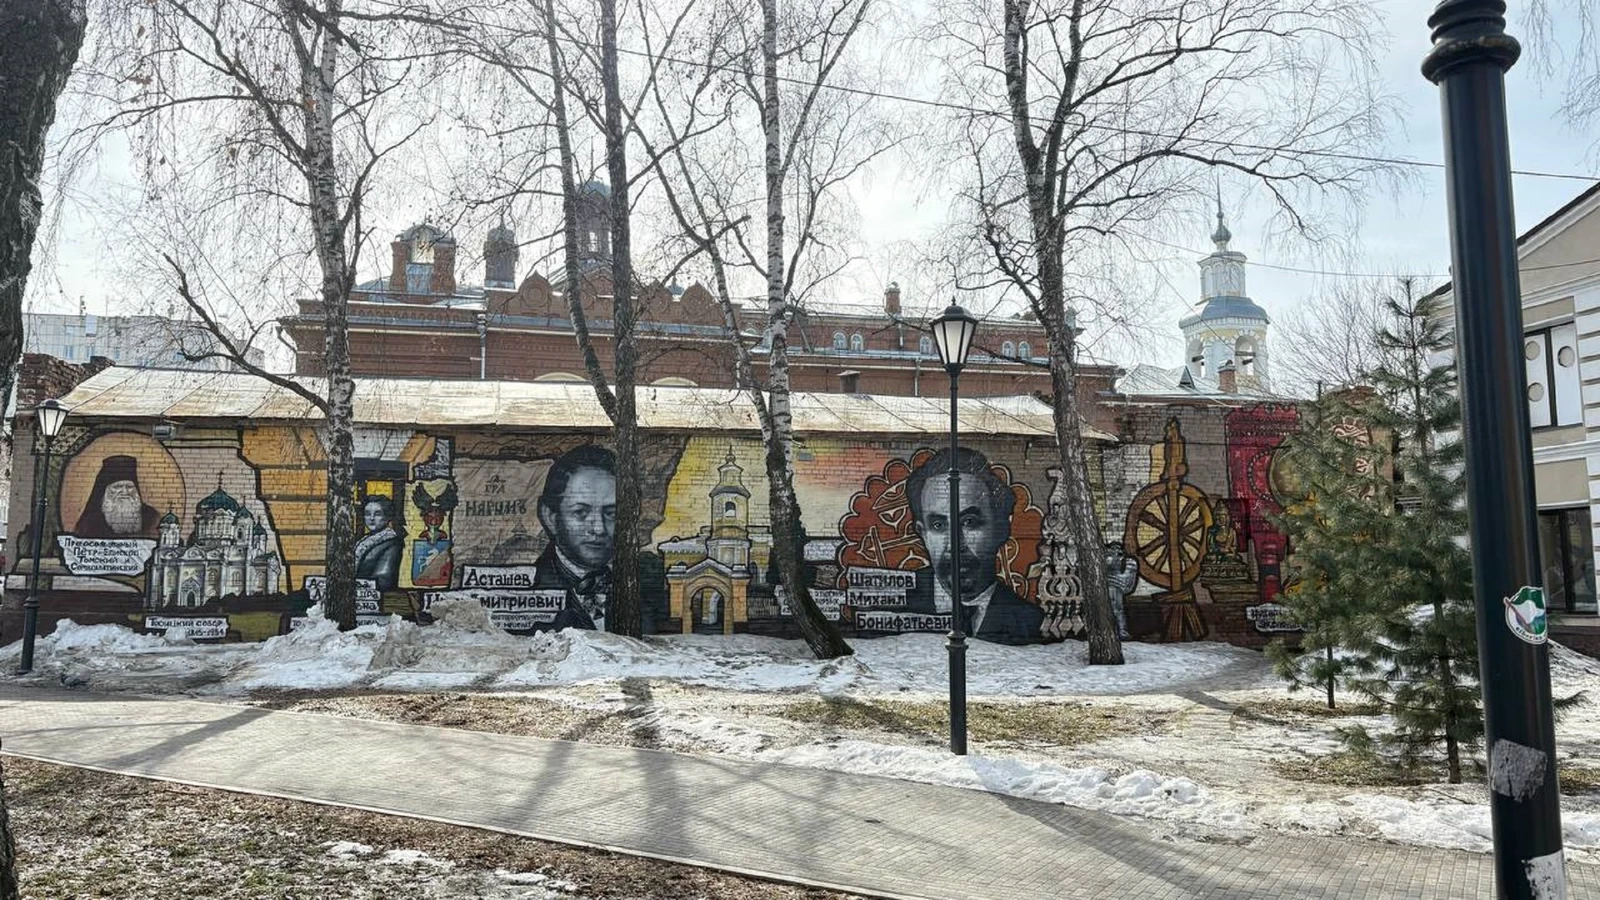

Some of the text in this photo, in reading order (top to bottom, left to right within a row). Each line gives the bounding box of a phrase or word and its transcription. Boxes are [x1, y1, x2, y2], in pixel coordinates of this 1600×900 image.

[464, 568, 532, 587] Асташев
[850, 573, 914, 588] Шатилов
[849, 592, 906, 605] Михаил
[857, 614, 952, 632] Бонифатьеви
